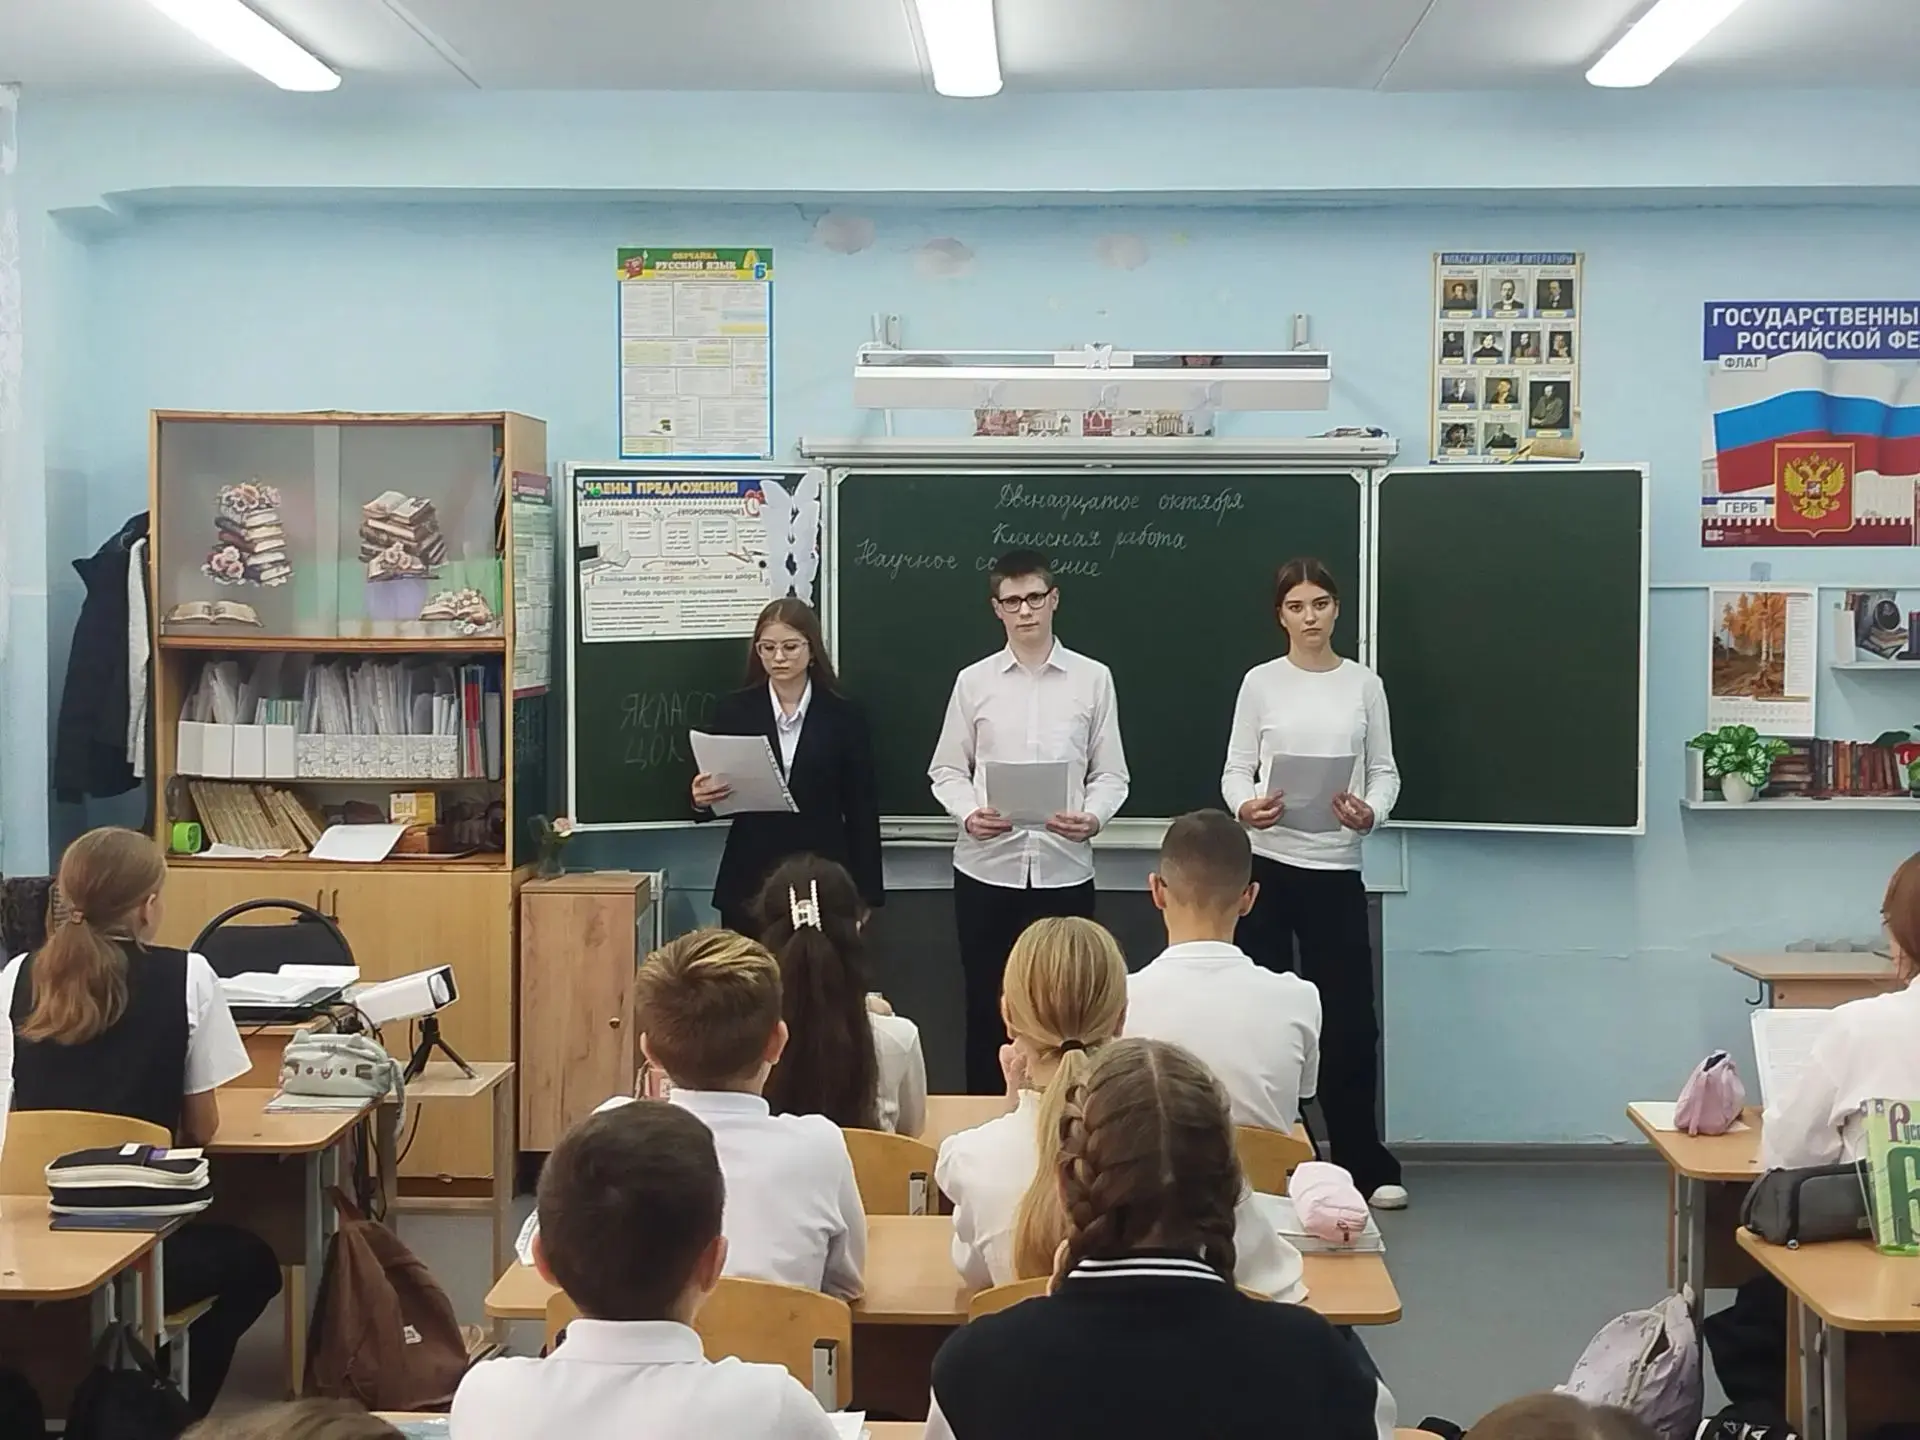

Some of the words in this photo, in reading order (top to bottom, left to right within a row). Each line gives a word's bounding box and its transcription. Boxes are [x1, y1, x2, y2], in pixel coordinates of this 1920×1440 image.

[655, 260, 704, 270] РУССКИЙ
[706, 260, 737, 270] ЯЗЫК
[1712, 306, 1919, 330] ГОСУДАРСТВЕННЫ
[1736, 327, 1881, 350] РОССИЙСКОЙ
[1724, 356, 1761, 369] ФЛАГ
[637, 482, 738, 496] ПРЕДЛОЖЕНИЯ
[995, 482, 1140, 521] Двенадцатое
[1159, 487, 1245, 527] октября
[1724, 501, 1758, 513] ГЕРБ
[992, 522, 1102, 548] Классная
[1109, 521, 1187, 560] работа
[854, 538, 959, 580] Научное
[975, 556, 1103, 578] соение
